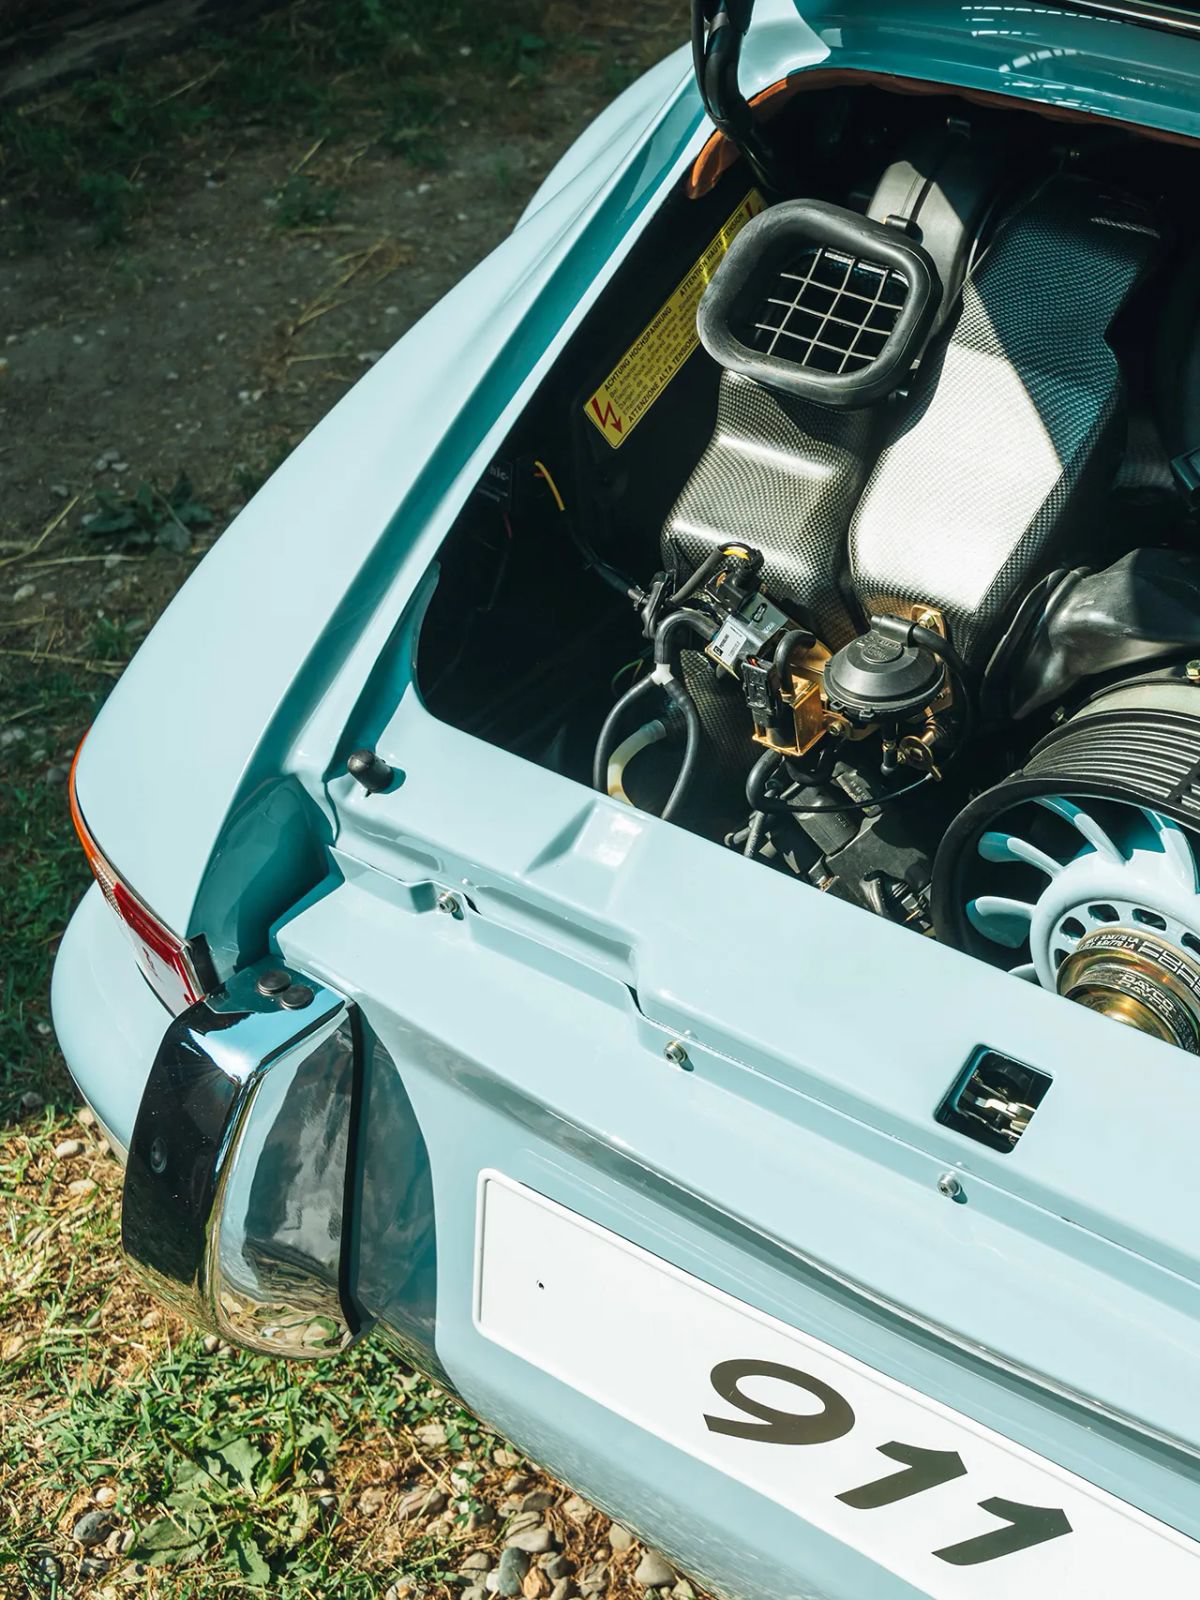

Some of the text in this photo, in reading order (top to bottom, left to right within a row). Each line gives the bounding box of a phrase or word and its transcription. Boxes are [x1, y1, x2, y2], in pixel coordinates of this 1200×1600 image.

[678, 261, 707, 297] ATTENTION
[705, 237, 723, 261] HAUTE
[722, 211, 745, 240] TENSION
[603, 304, 671, 392] ACHTUNG HOCHSPANNUNG
[627, 380, 659, 423] ATTENZIONE
[658, 363, 672, 383] ALTA
[672, 331, 697, 365] TENSIONE
[1121, 973, 1175, 1011] DAYCO
[702, 1358, 1073, 1567] 911
